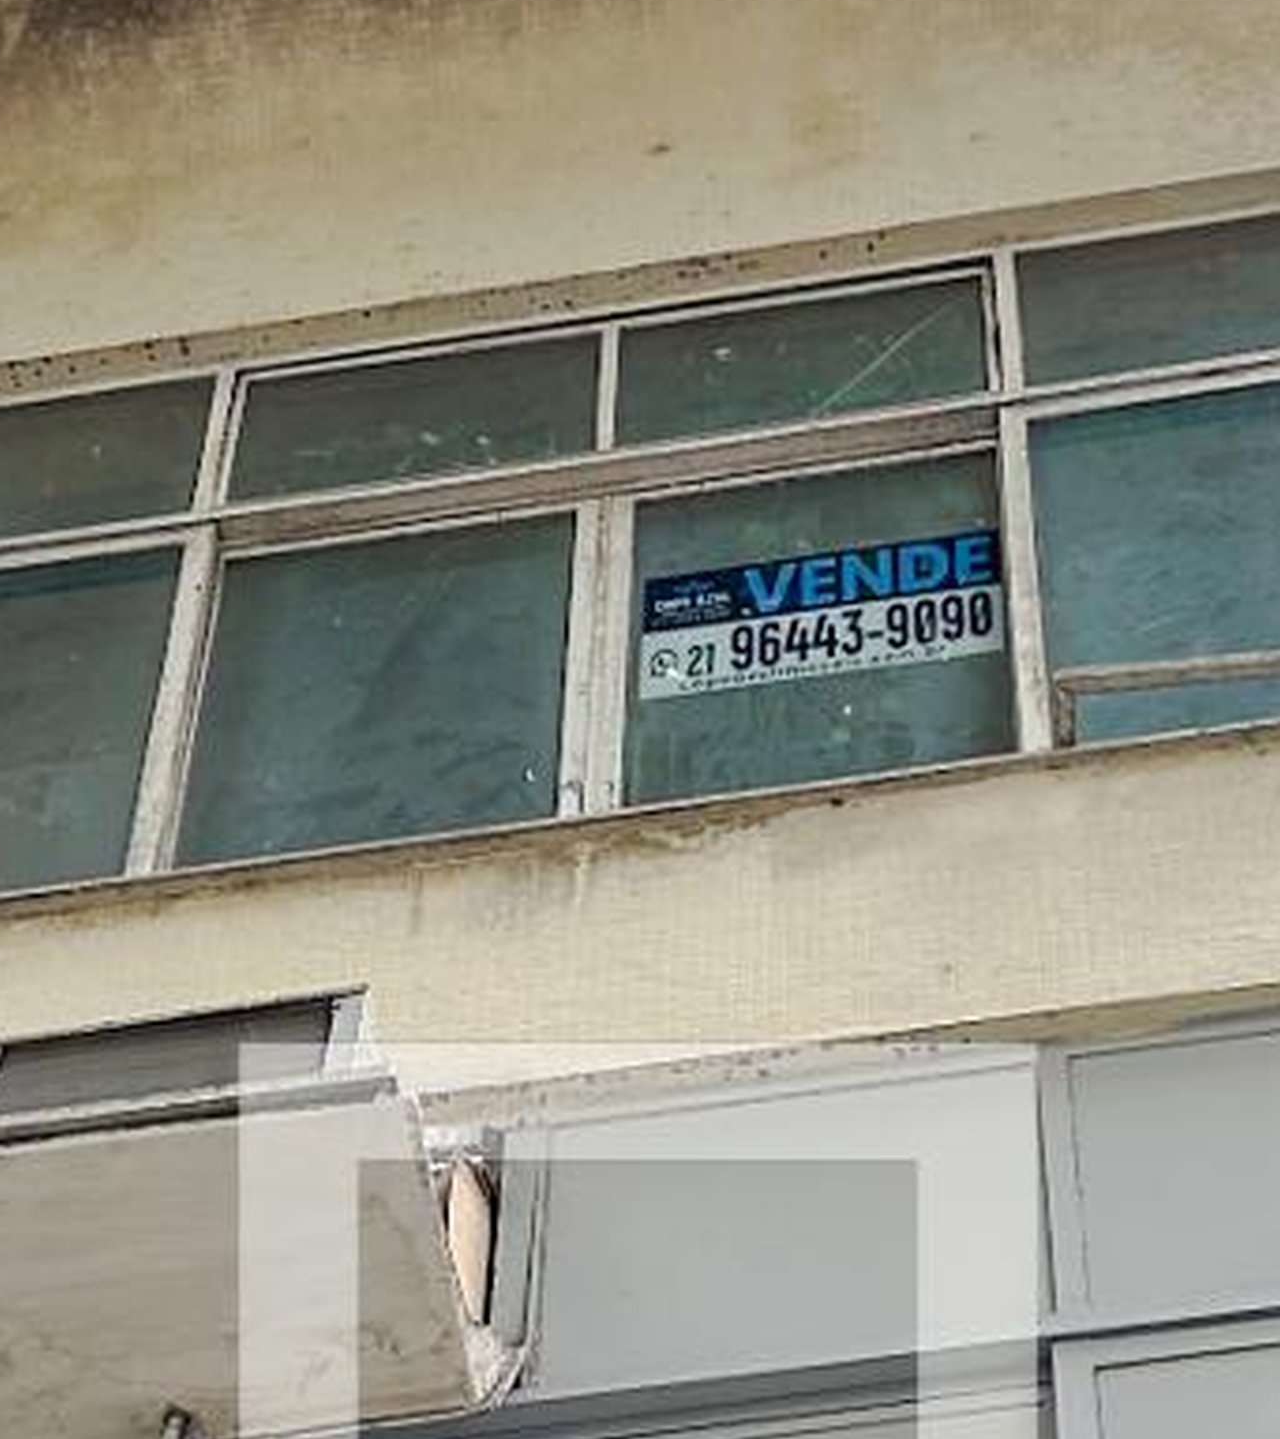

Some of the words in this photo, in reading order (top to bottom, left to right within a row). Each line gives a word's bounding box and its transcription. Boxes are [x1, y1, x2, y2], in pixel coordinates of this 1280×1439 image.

[743, 536, 993, 613] VENDE
[686, 642, 716, 678] 21
[730, 591, 994, 671] 96443-9090
